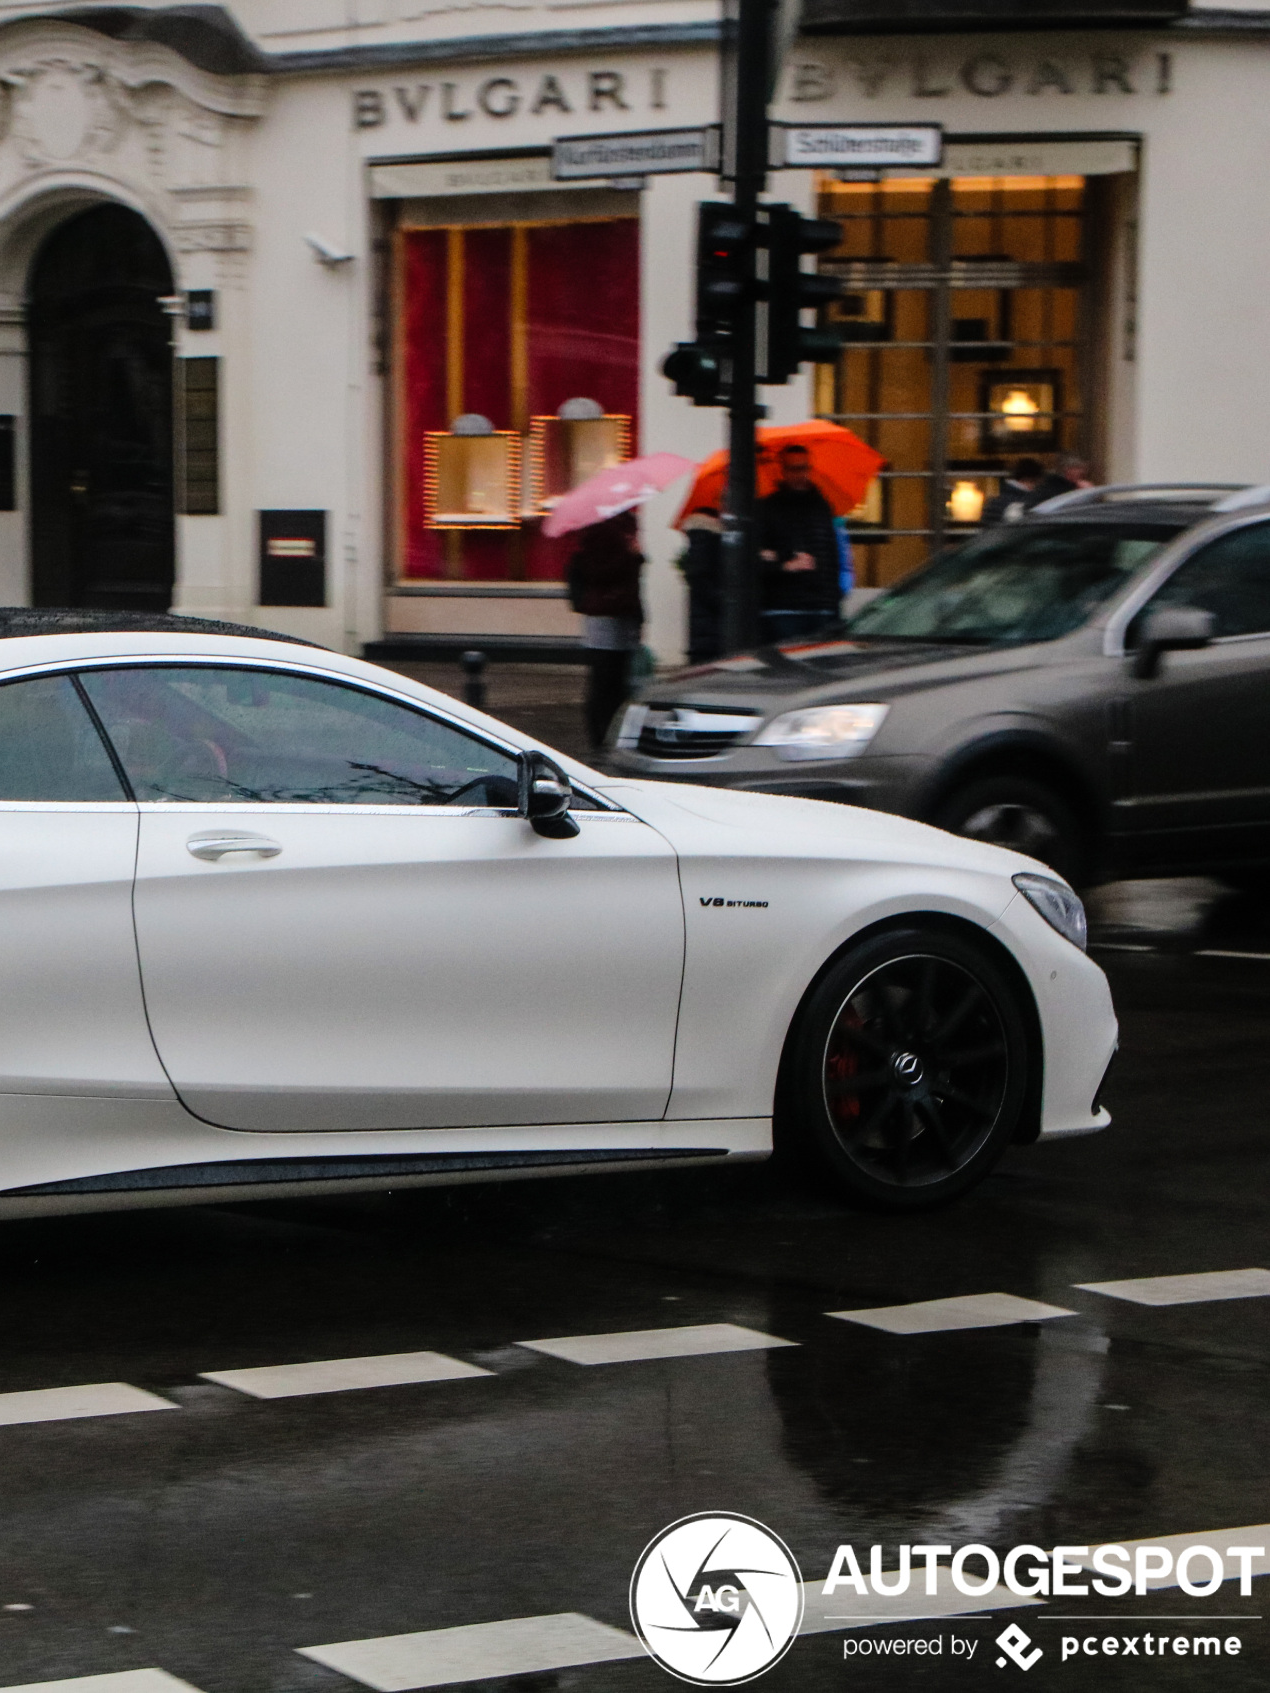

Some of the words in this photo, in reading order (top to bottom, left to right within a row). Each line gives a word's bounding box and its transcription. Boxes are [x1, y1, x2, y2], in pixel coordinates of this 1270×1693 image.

[352, 66, 669, 129] BVLGARI
[794, 51, 1172, 100] BVLGARI
[699, 897, 724, 907] V8
[727, 900, 769, 908] BITURBO
